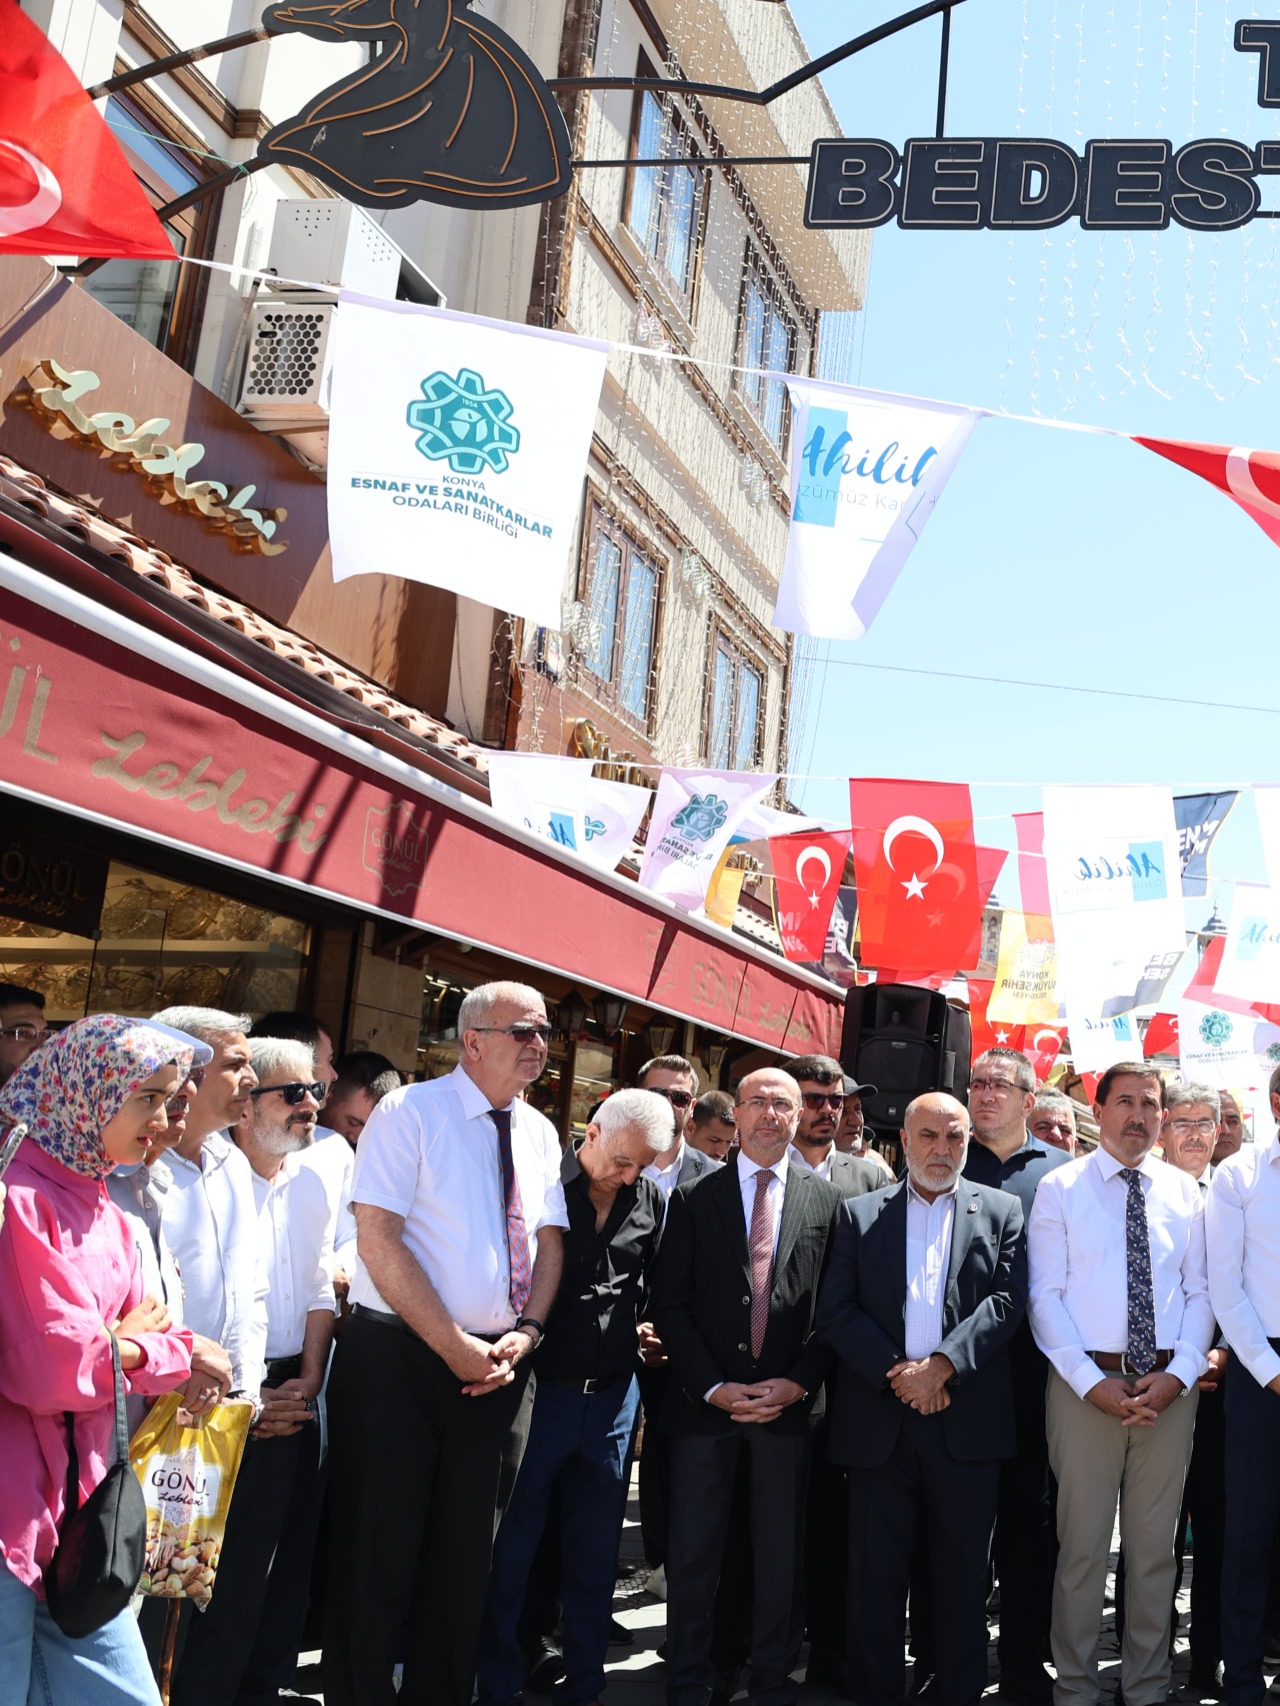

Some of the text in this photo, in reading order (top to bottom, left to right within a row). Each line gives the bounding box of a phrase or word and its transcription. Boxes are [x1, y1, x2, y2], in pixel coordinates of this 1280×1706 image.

[442, 475, 486, 491] KONYA
[800, 484, 868, 507] zümüz
[351, 478, 554, 539] ESNAF VE SANATKARLAR
[392, 496, 469, 516] ODALARI
[91, 729, 329, 855] Leblebi
[372, 826, 420, 864] GÖNÜL
[1, 842, 87, 902] ÖNÜL
[152, 1467, 210, 1496] GÖNÜ
